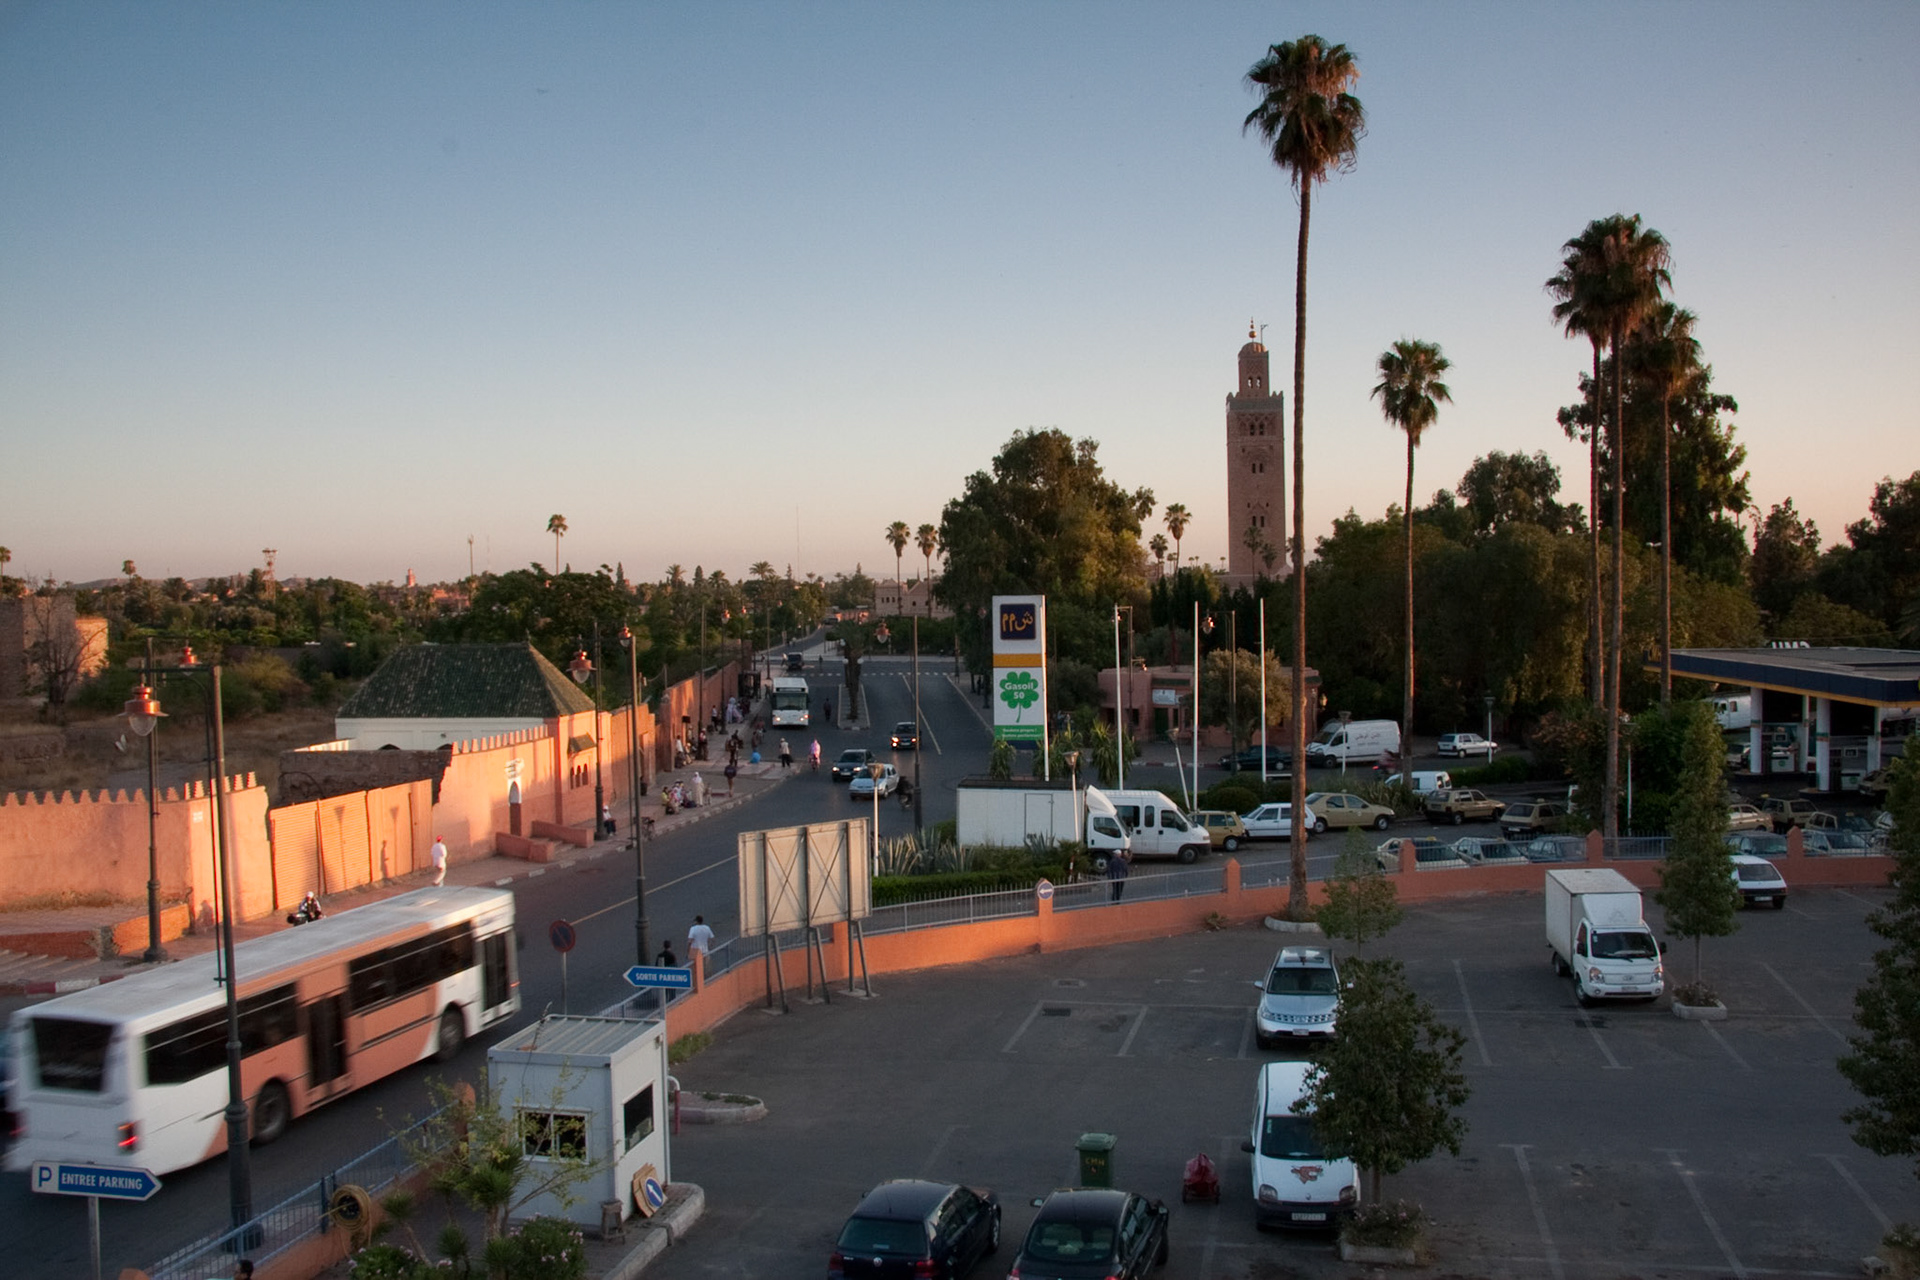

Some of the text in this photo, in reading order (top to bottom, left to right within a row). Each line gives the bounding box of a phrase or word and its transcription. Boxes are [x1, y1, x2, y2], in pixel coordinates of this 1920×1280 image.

[1004, 682, 1034, 690] Gasoil
[1013, 691, 1025, 699] 50
[635, 972, 688, 983] SORTIE PARKING
[38, 1166, 143, 1190] P ENTREE PARKING
